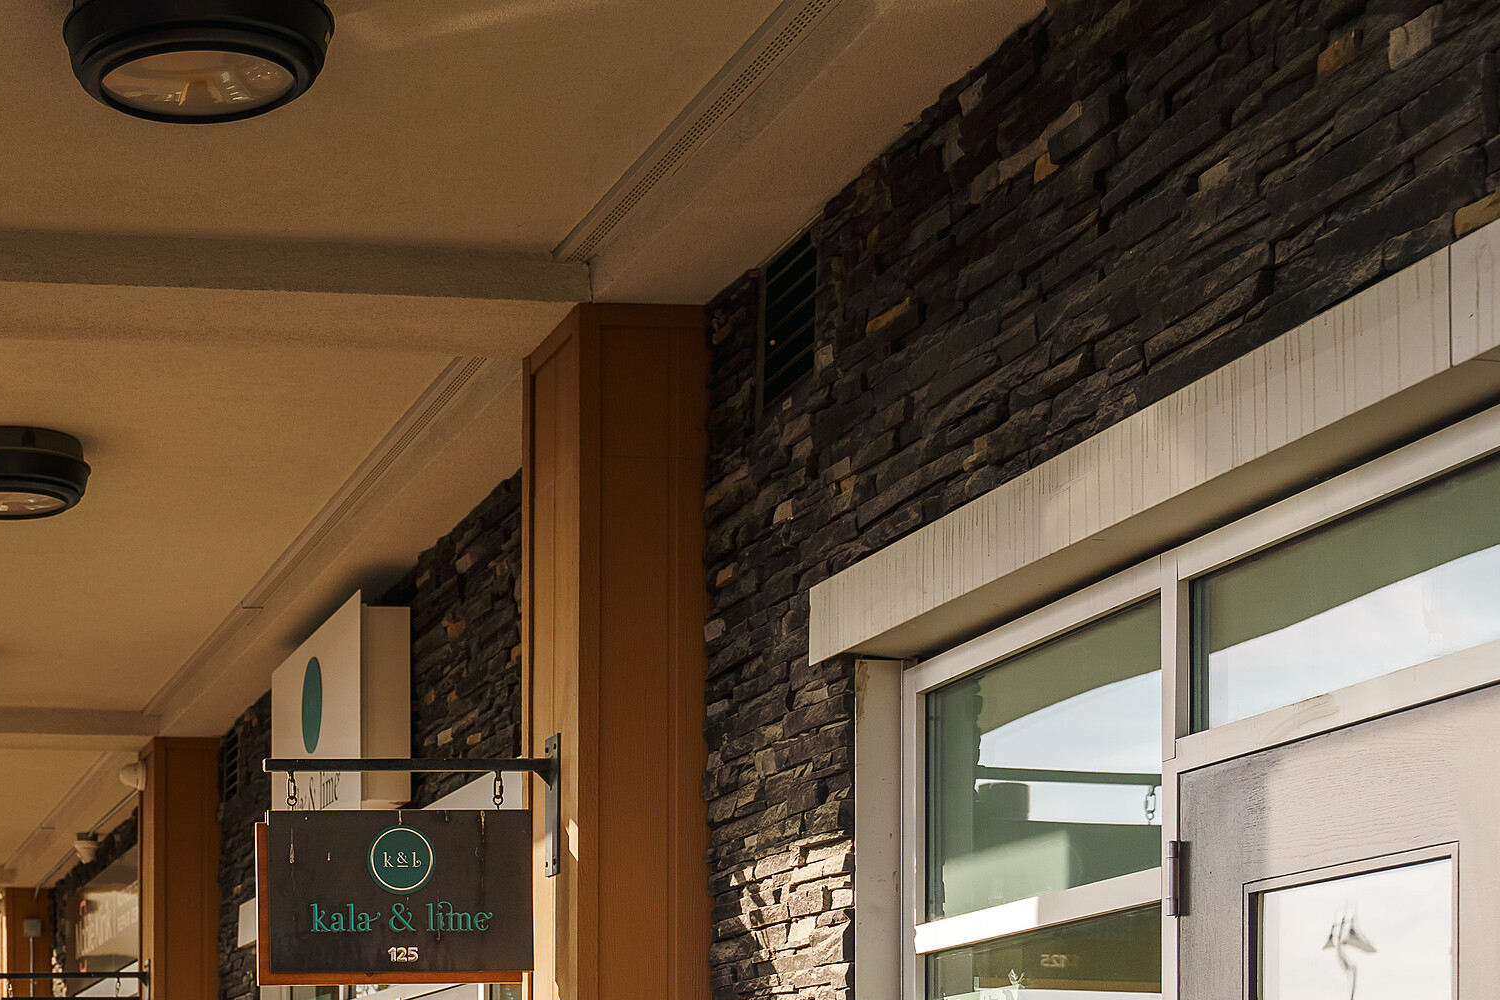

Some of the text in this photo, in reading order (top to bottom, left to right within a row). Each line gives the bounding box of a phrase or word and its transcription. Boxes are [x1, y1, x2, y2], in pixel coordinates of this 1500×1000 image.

[383, 851, 394, 868] k
[396, 851, 408, 868] &
[310, 901, 493, 932] kala & lime
[387, 946, 419, 963] 125
